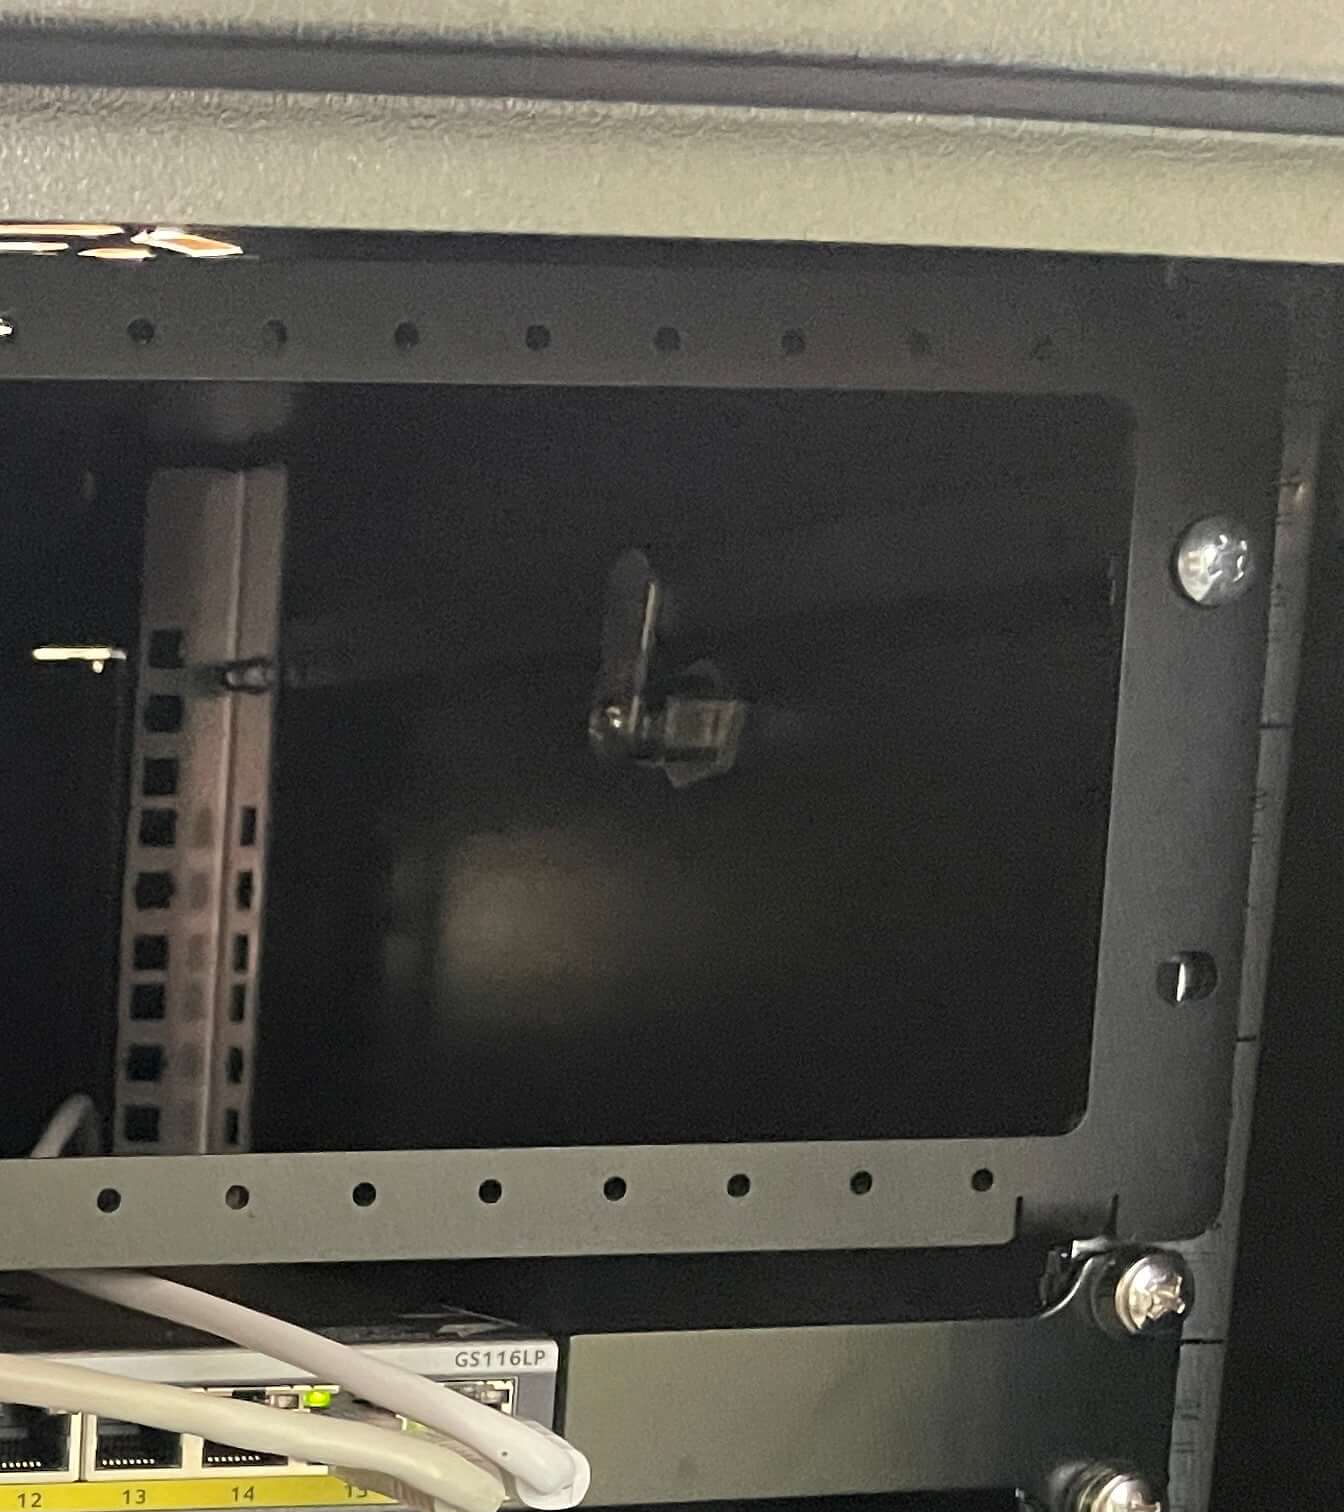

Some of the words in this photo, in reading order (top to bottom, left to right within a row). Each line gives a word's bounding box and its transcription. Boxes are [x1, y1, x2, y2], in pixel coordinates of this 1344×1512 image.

[455, 1350, 546, 1368] GS116LP
[17, 1492, 43, 1508] 12
[122, 1489, 146, 1505] 13
[231, 1485, 255, 1502] 14
